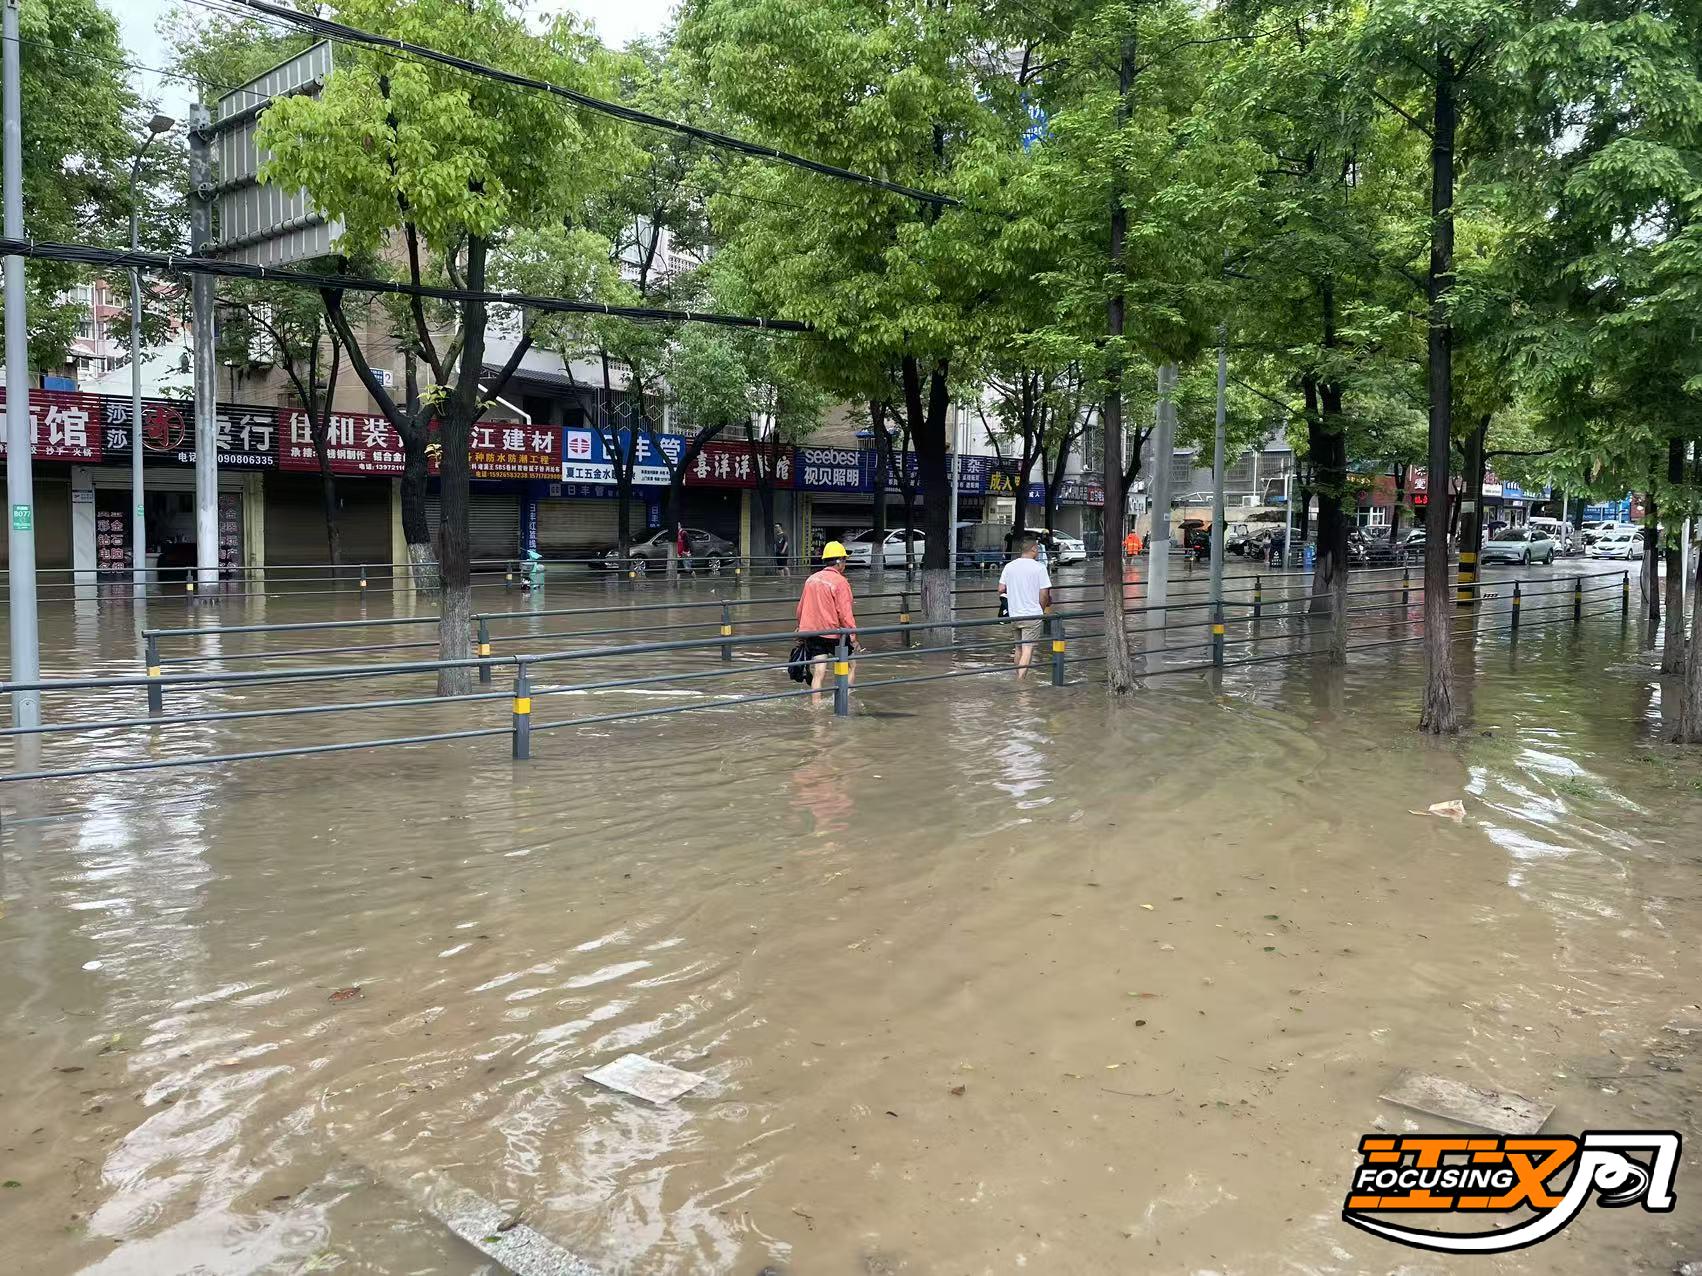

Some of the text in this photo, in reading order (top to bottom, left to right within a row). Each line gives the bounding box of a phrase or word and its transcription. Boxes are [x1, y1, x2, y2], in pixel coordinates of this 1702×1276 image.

[106, 403, 128, 448] 莎莎
[289, 412, 404, 448] 佳和装
[372, 451, 406, 463] 铝合金
[804, 448, 860, 466] seebest
[803, 466, 860, 487] 视贝照明
